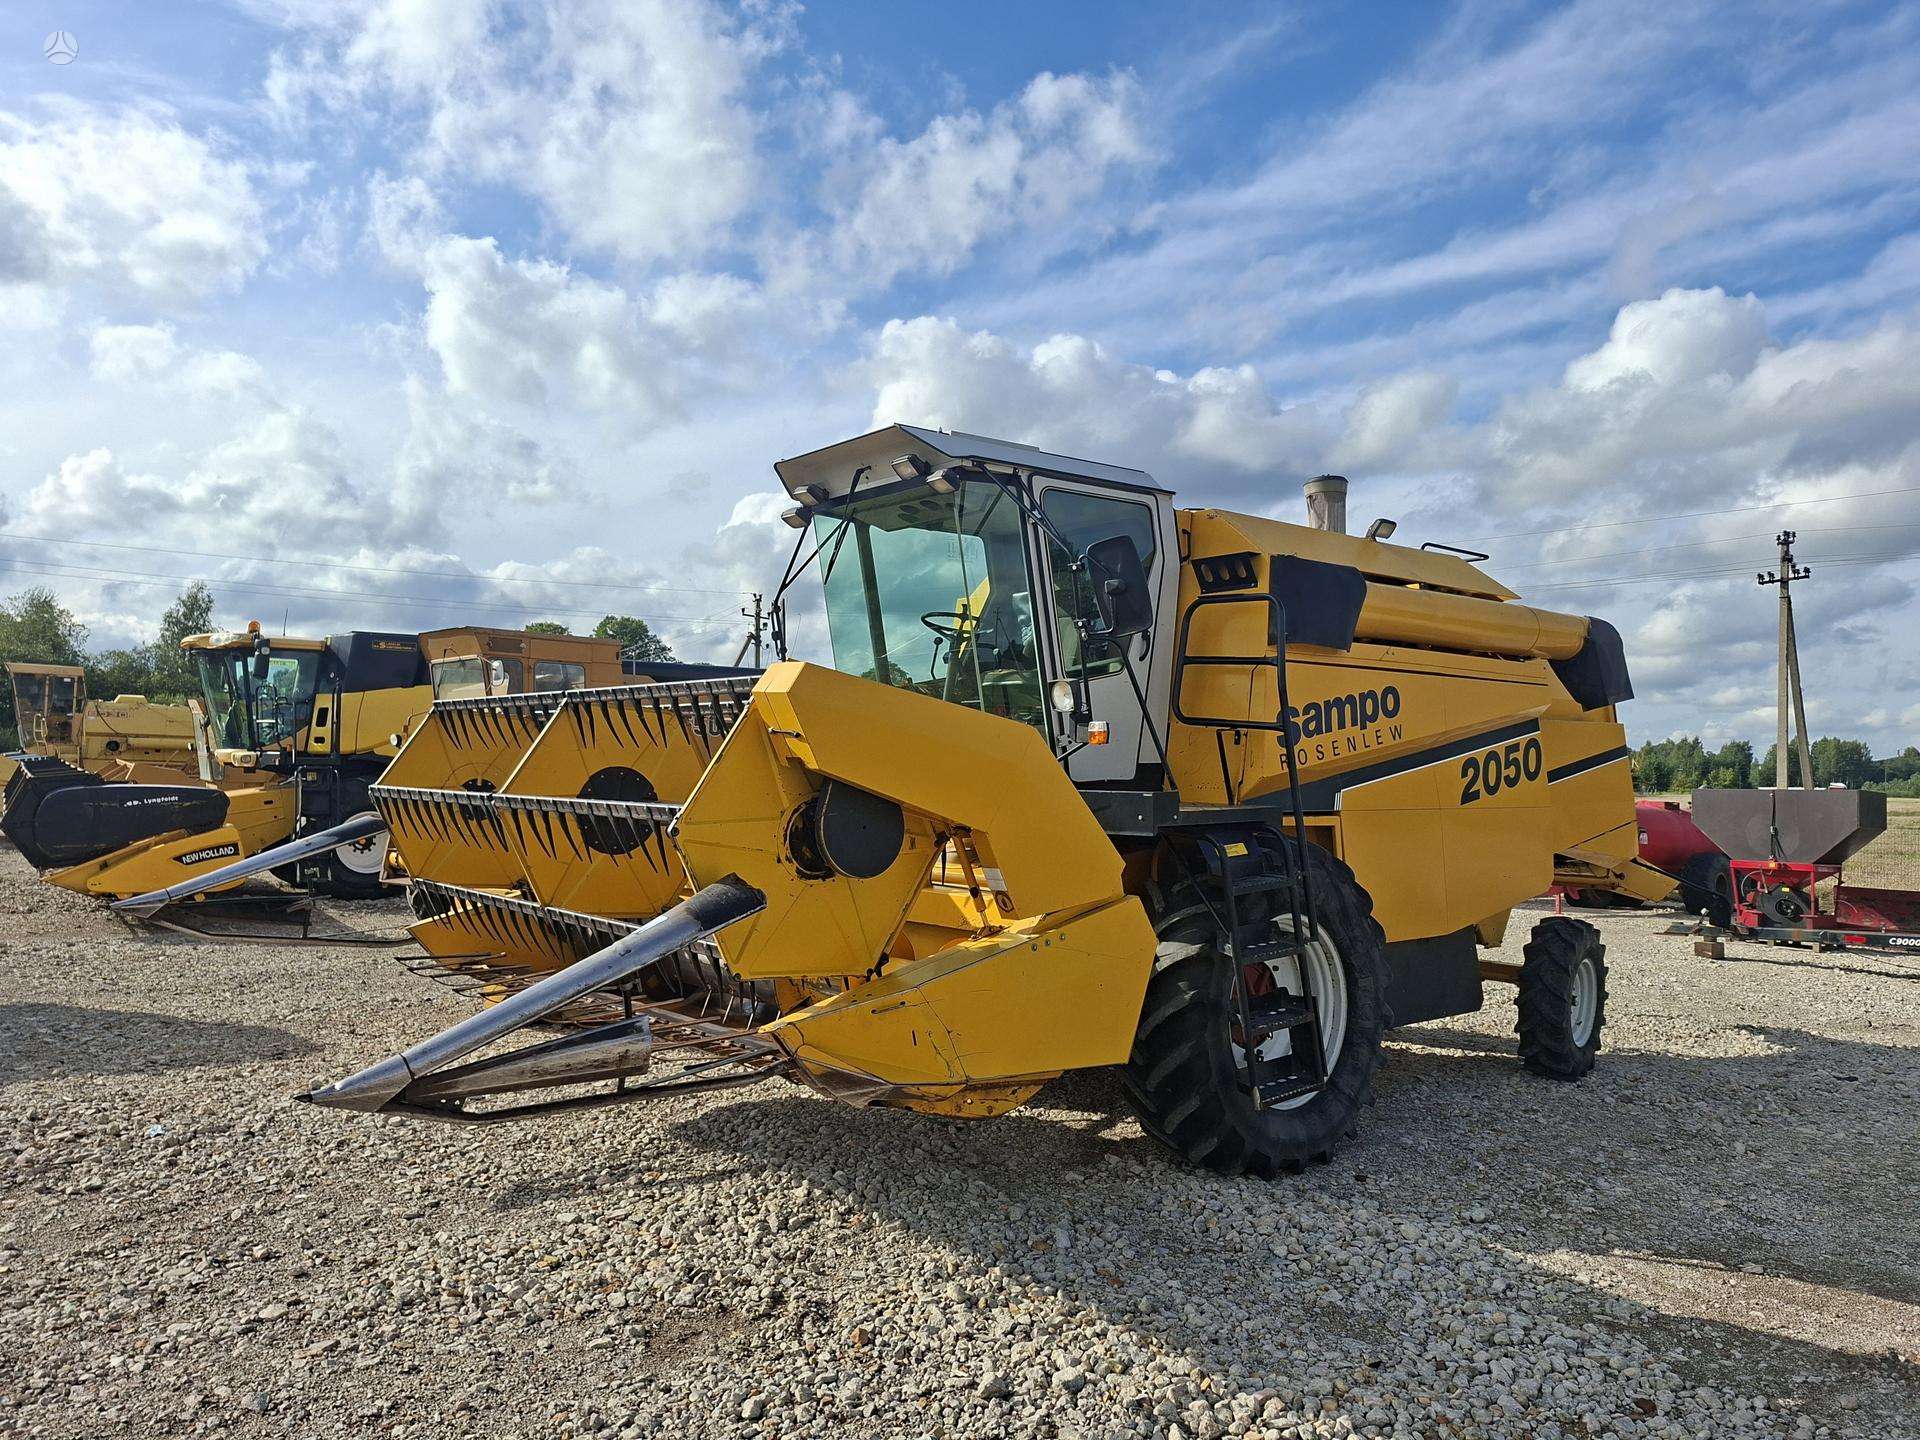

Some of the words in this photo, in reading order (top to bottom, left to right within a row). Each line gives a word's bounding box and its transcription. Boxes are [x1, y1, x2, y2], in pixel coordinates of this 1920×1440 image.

[1276, 685, 1401, 748] sampo
[1279, 724, 1402, 771] ROSENLEW
[1460, 737, 1543, 806] 2050
[182, 851, 200, 864] NEW
[199, 846, 235, 860] HOLLAND
[1889, 938, 1920, 946] C9000
